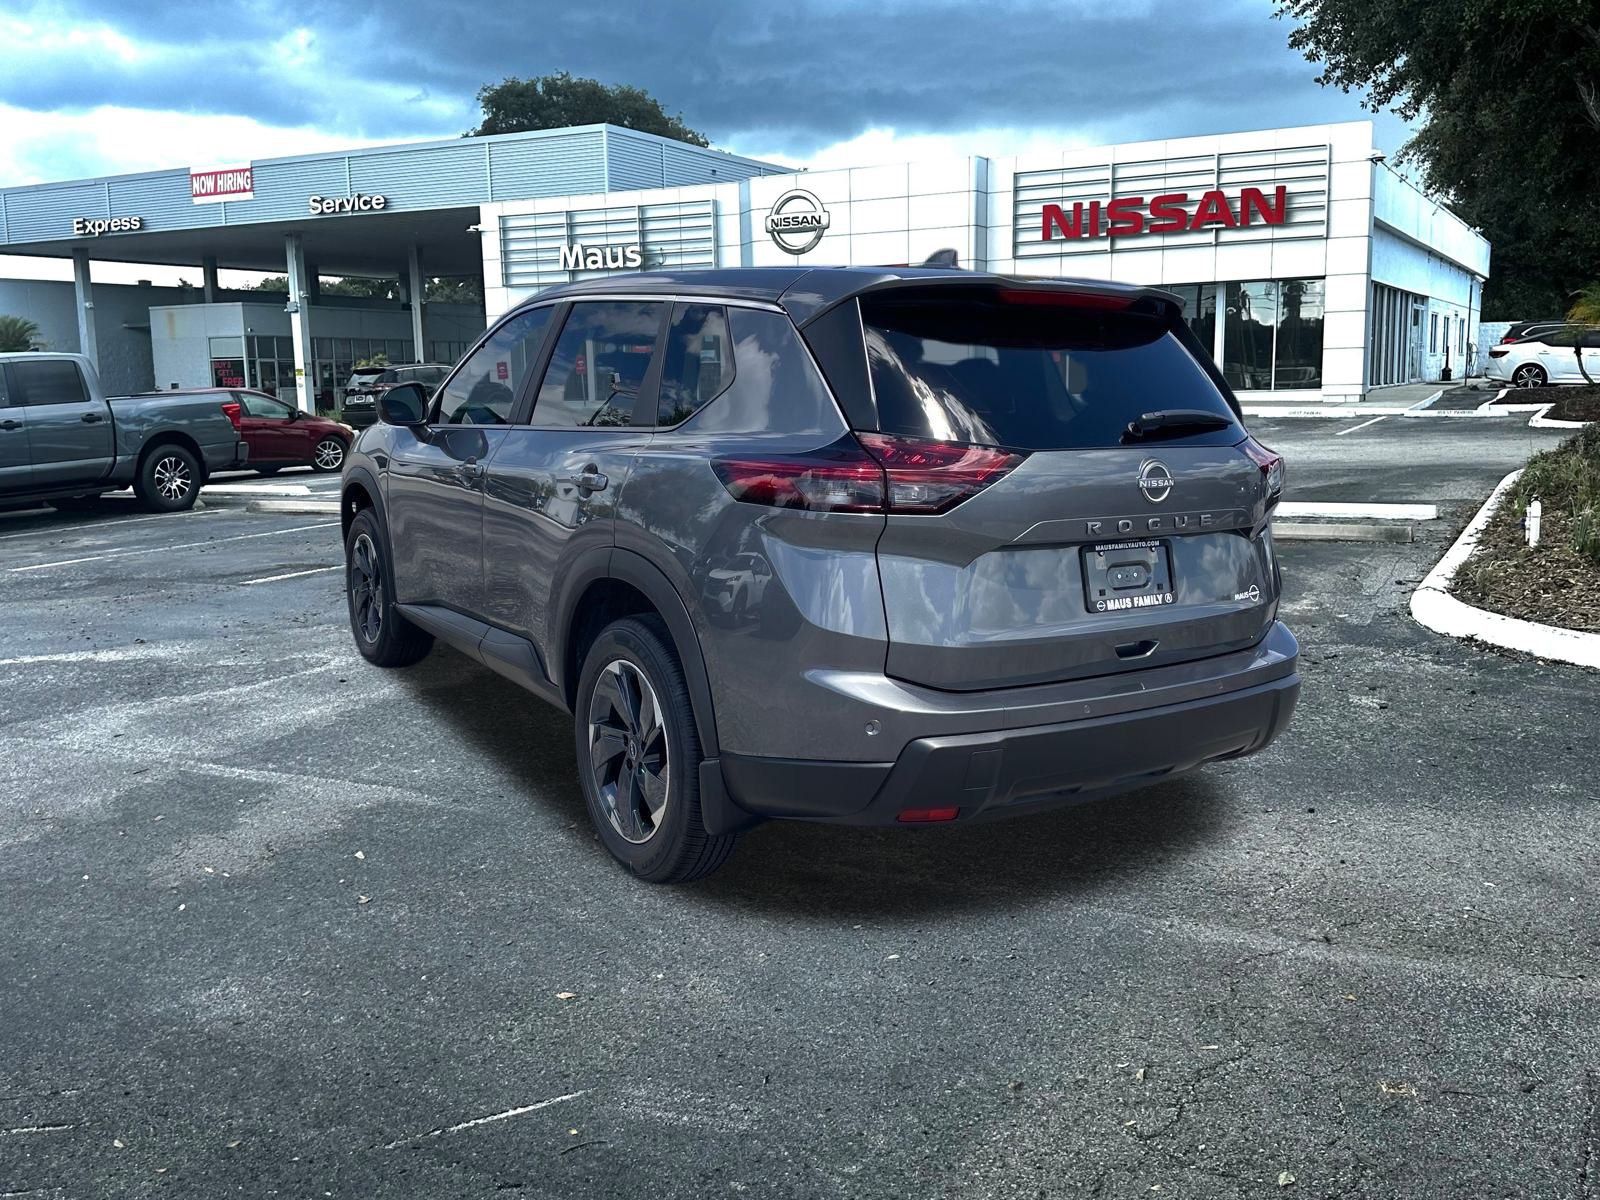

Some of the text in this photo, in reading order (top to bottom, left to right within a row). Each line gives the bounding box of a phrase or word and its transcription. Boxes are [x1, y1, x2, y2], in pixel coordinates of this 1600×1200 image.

[192, 171, 251, 195] NOW HIRING
[309, 193, 385, 215] Service
[1042, 185, 1287, 241] NISSAN
[73, 216, 141, 236] Express
[770, 214, 822, 229] NISSAN
[558, 243, 643, 271] Maus
[223, 377, 244, 387] FREE
[1139, 478, 1175, 489] NISSAN
[1086, 514, 1213, 536] ROGUE
[1095, 540, 1160, 551] MAUSFAMILYAUTO.COM
[1107, 593, 1163, 611] MAUS FAMILY
[1234, 591, 1250, 601] MAUS
